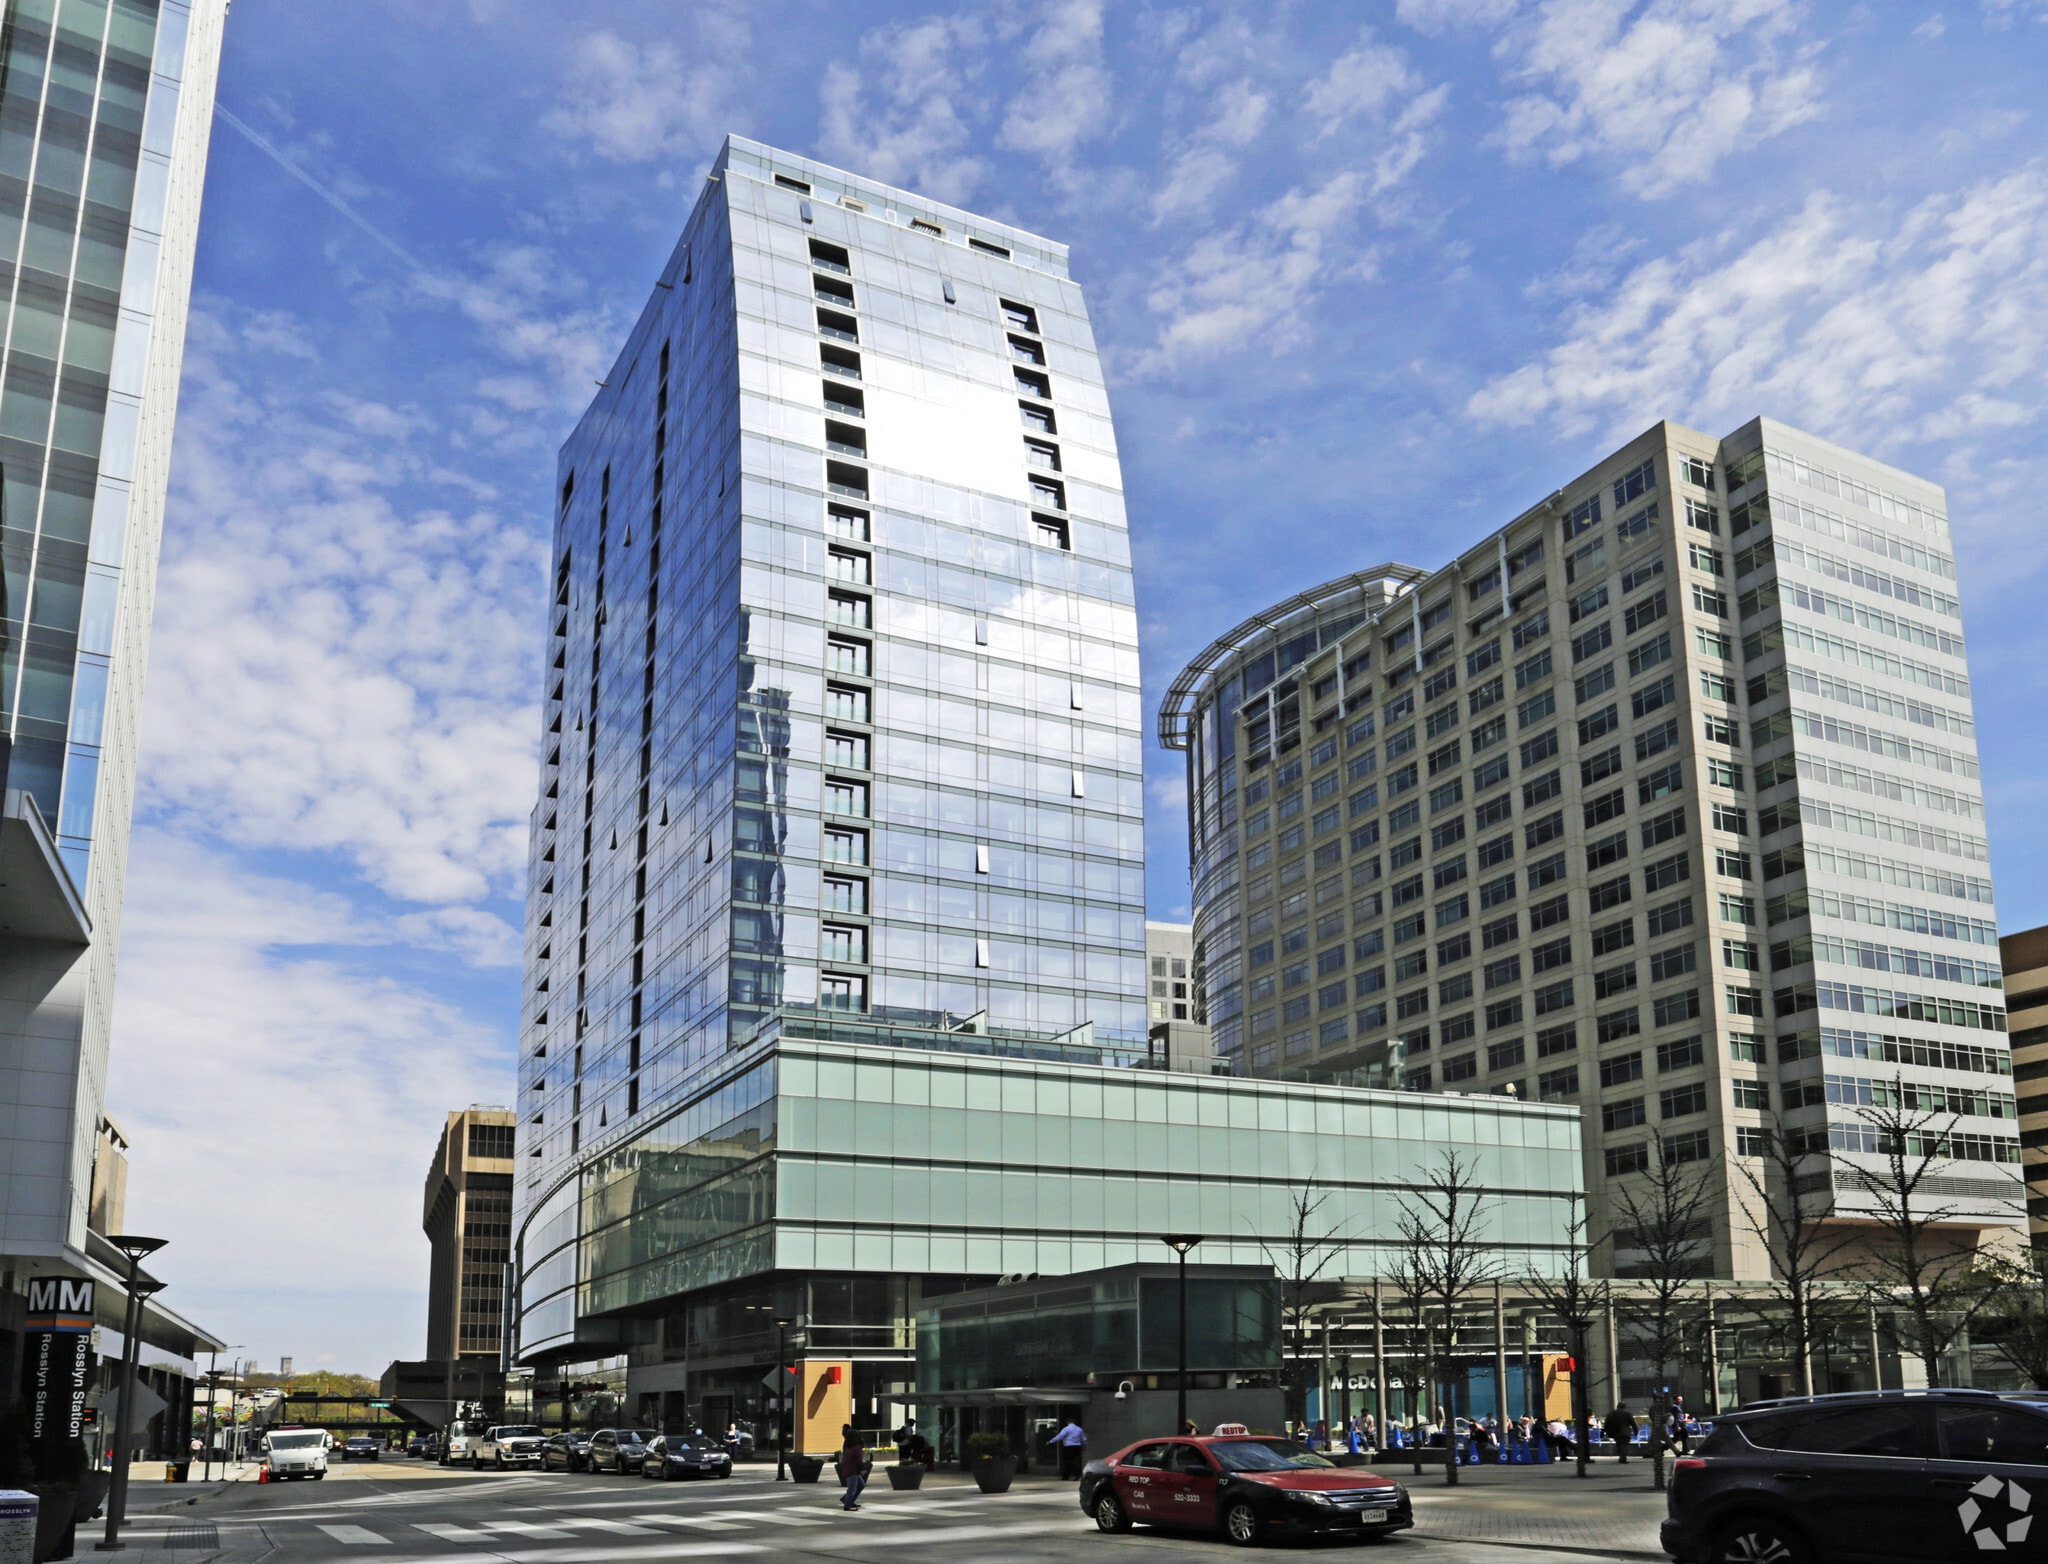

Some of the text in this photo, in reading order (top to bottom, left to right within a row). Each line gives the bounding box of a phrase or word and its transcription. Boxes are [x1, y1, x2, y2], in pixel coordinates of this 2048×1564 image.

[29, 1281, 56, 1311] M
[59, 1280, 93, 1312] M
[33, 1334, 52, 1438] Rosslyn Station
[69, 1335, 90, 1438] Rosslyn Station
[1129, 1475, 1139, 1483] RED
[1133, 1490, 1144, 1498] CAB
